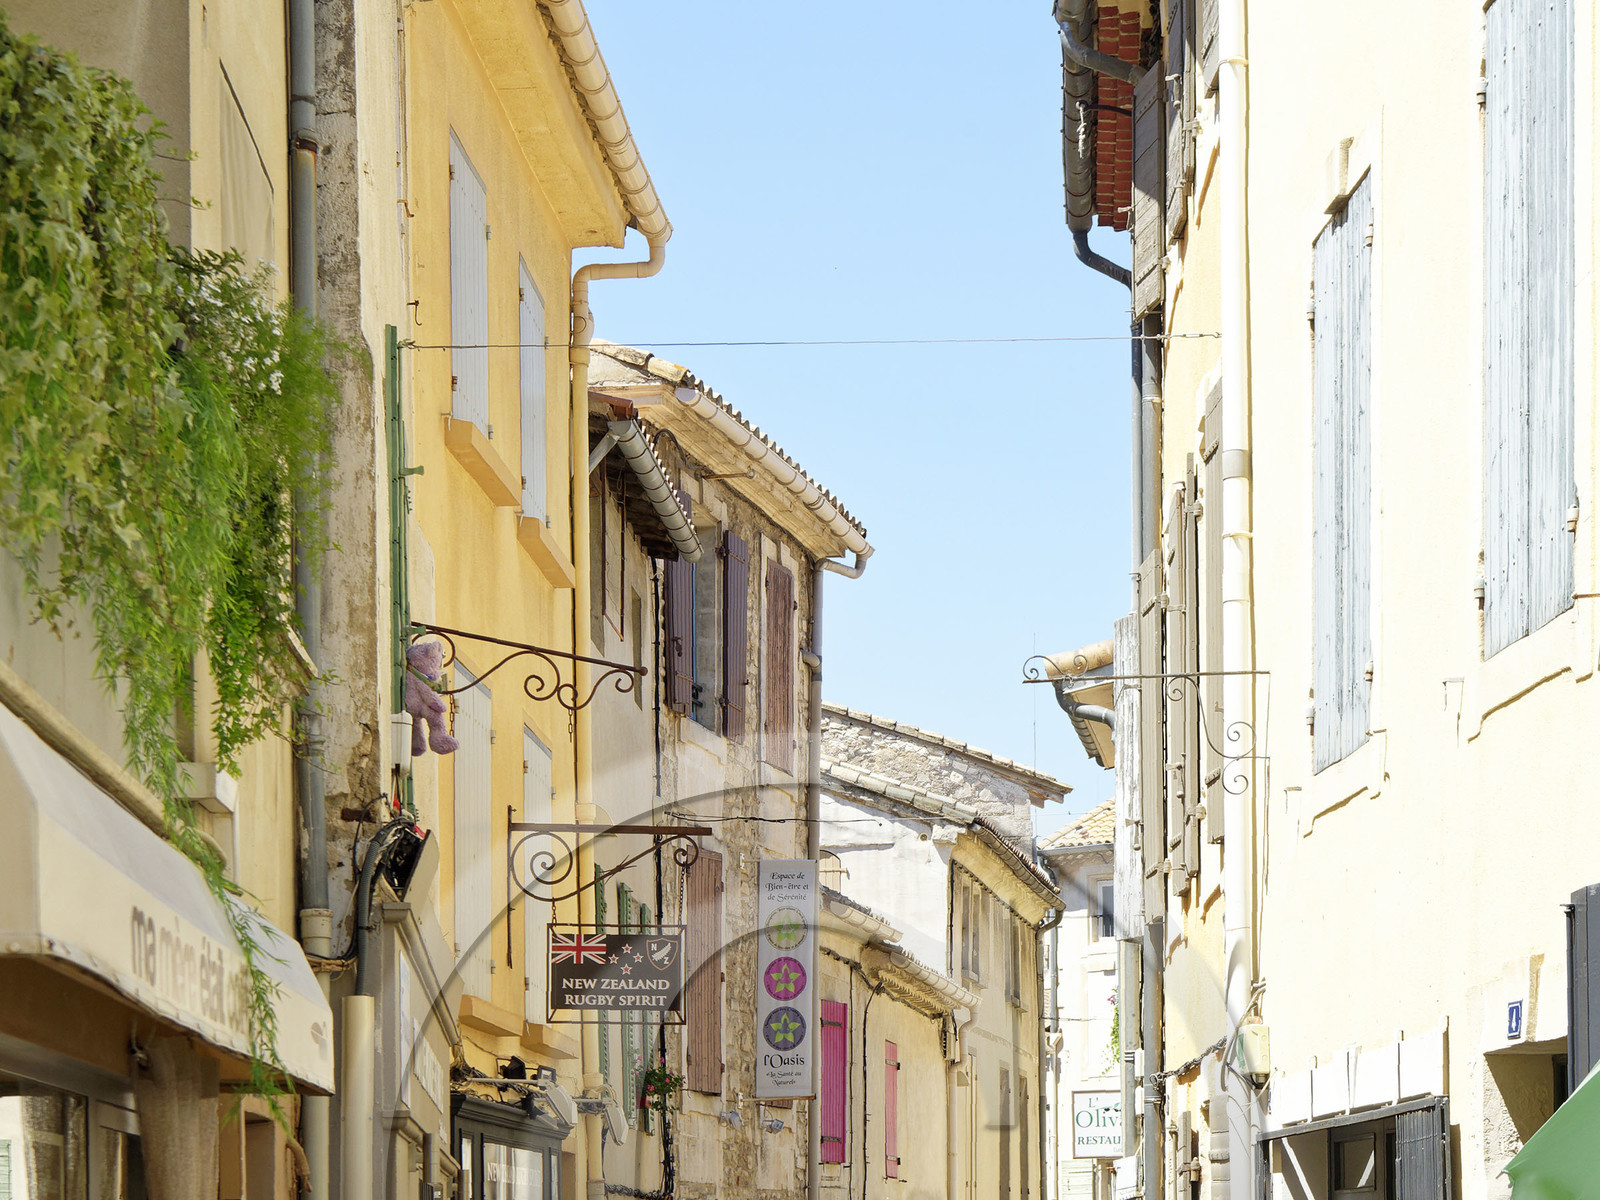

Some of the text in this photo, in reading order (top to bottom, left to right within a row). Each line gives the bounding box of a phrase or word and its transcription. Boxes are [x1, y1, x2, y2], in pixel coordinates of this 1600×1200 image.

[770, 871, 805, 882] Espace de
[767, 893, 807, 902] de Sérénité
[131, 905, 156, 988] ma
[651, 943, 657, 951] N
[663, 956, 670, 965] Z
[561, 978, 670, 990] NEW ZEALAND
[564, 994, 667, 1006] RUGBY SPIRIT
[1075, 1108, 1122, 1128] Oliv
[1077, 1135, 1121, 1146] RESTAU
